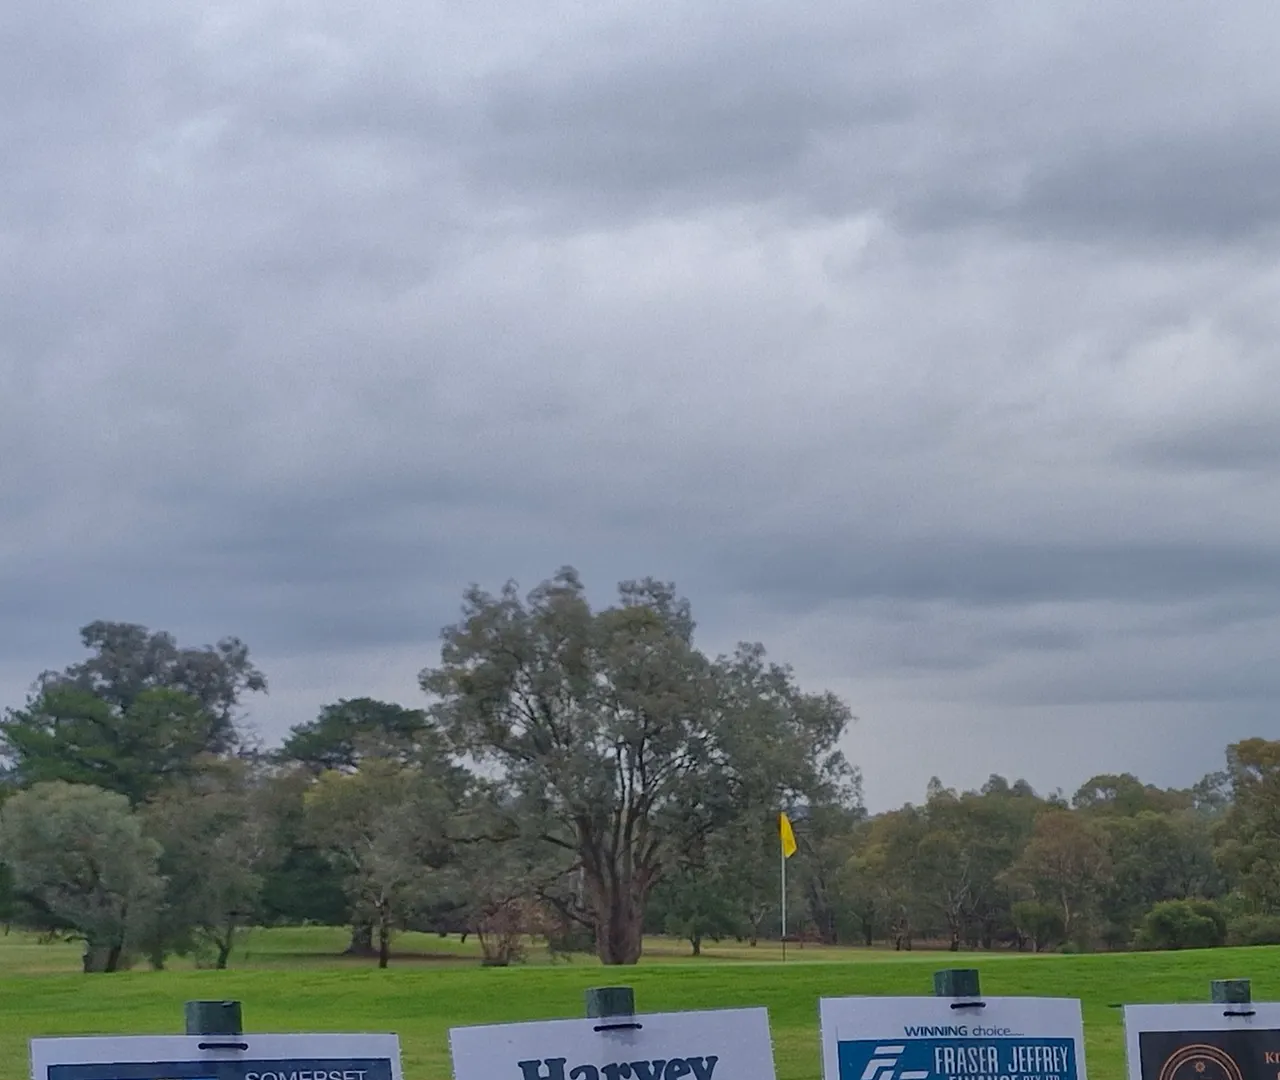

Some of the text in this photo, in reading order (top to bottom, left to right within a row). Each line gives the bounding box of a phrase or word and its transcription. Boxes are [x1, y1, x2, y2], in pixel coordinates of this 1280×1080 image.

[904, 1025, 968, 1037] WINNING
[933, 1046, 1069, 1075] FRASER JEFFREY
